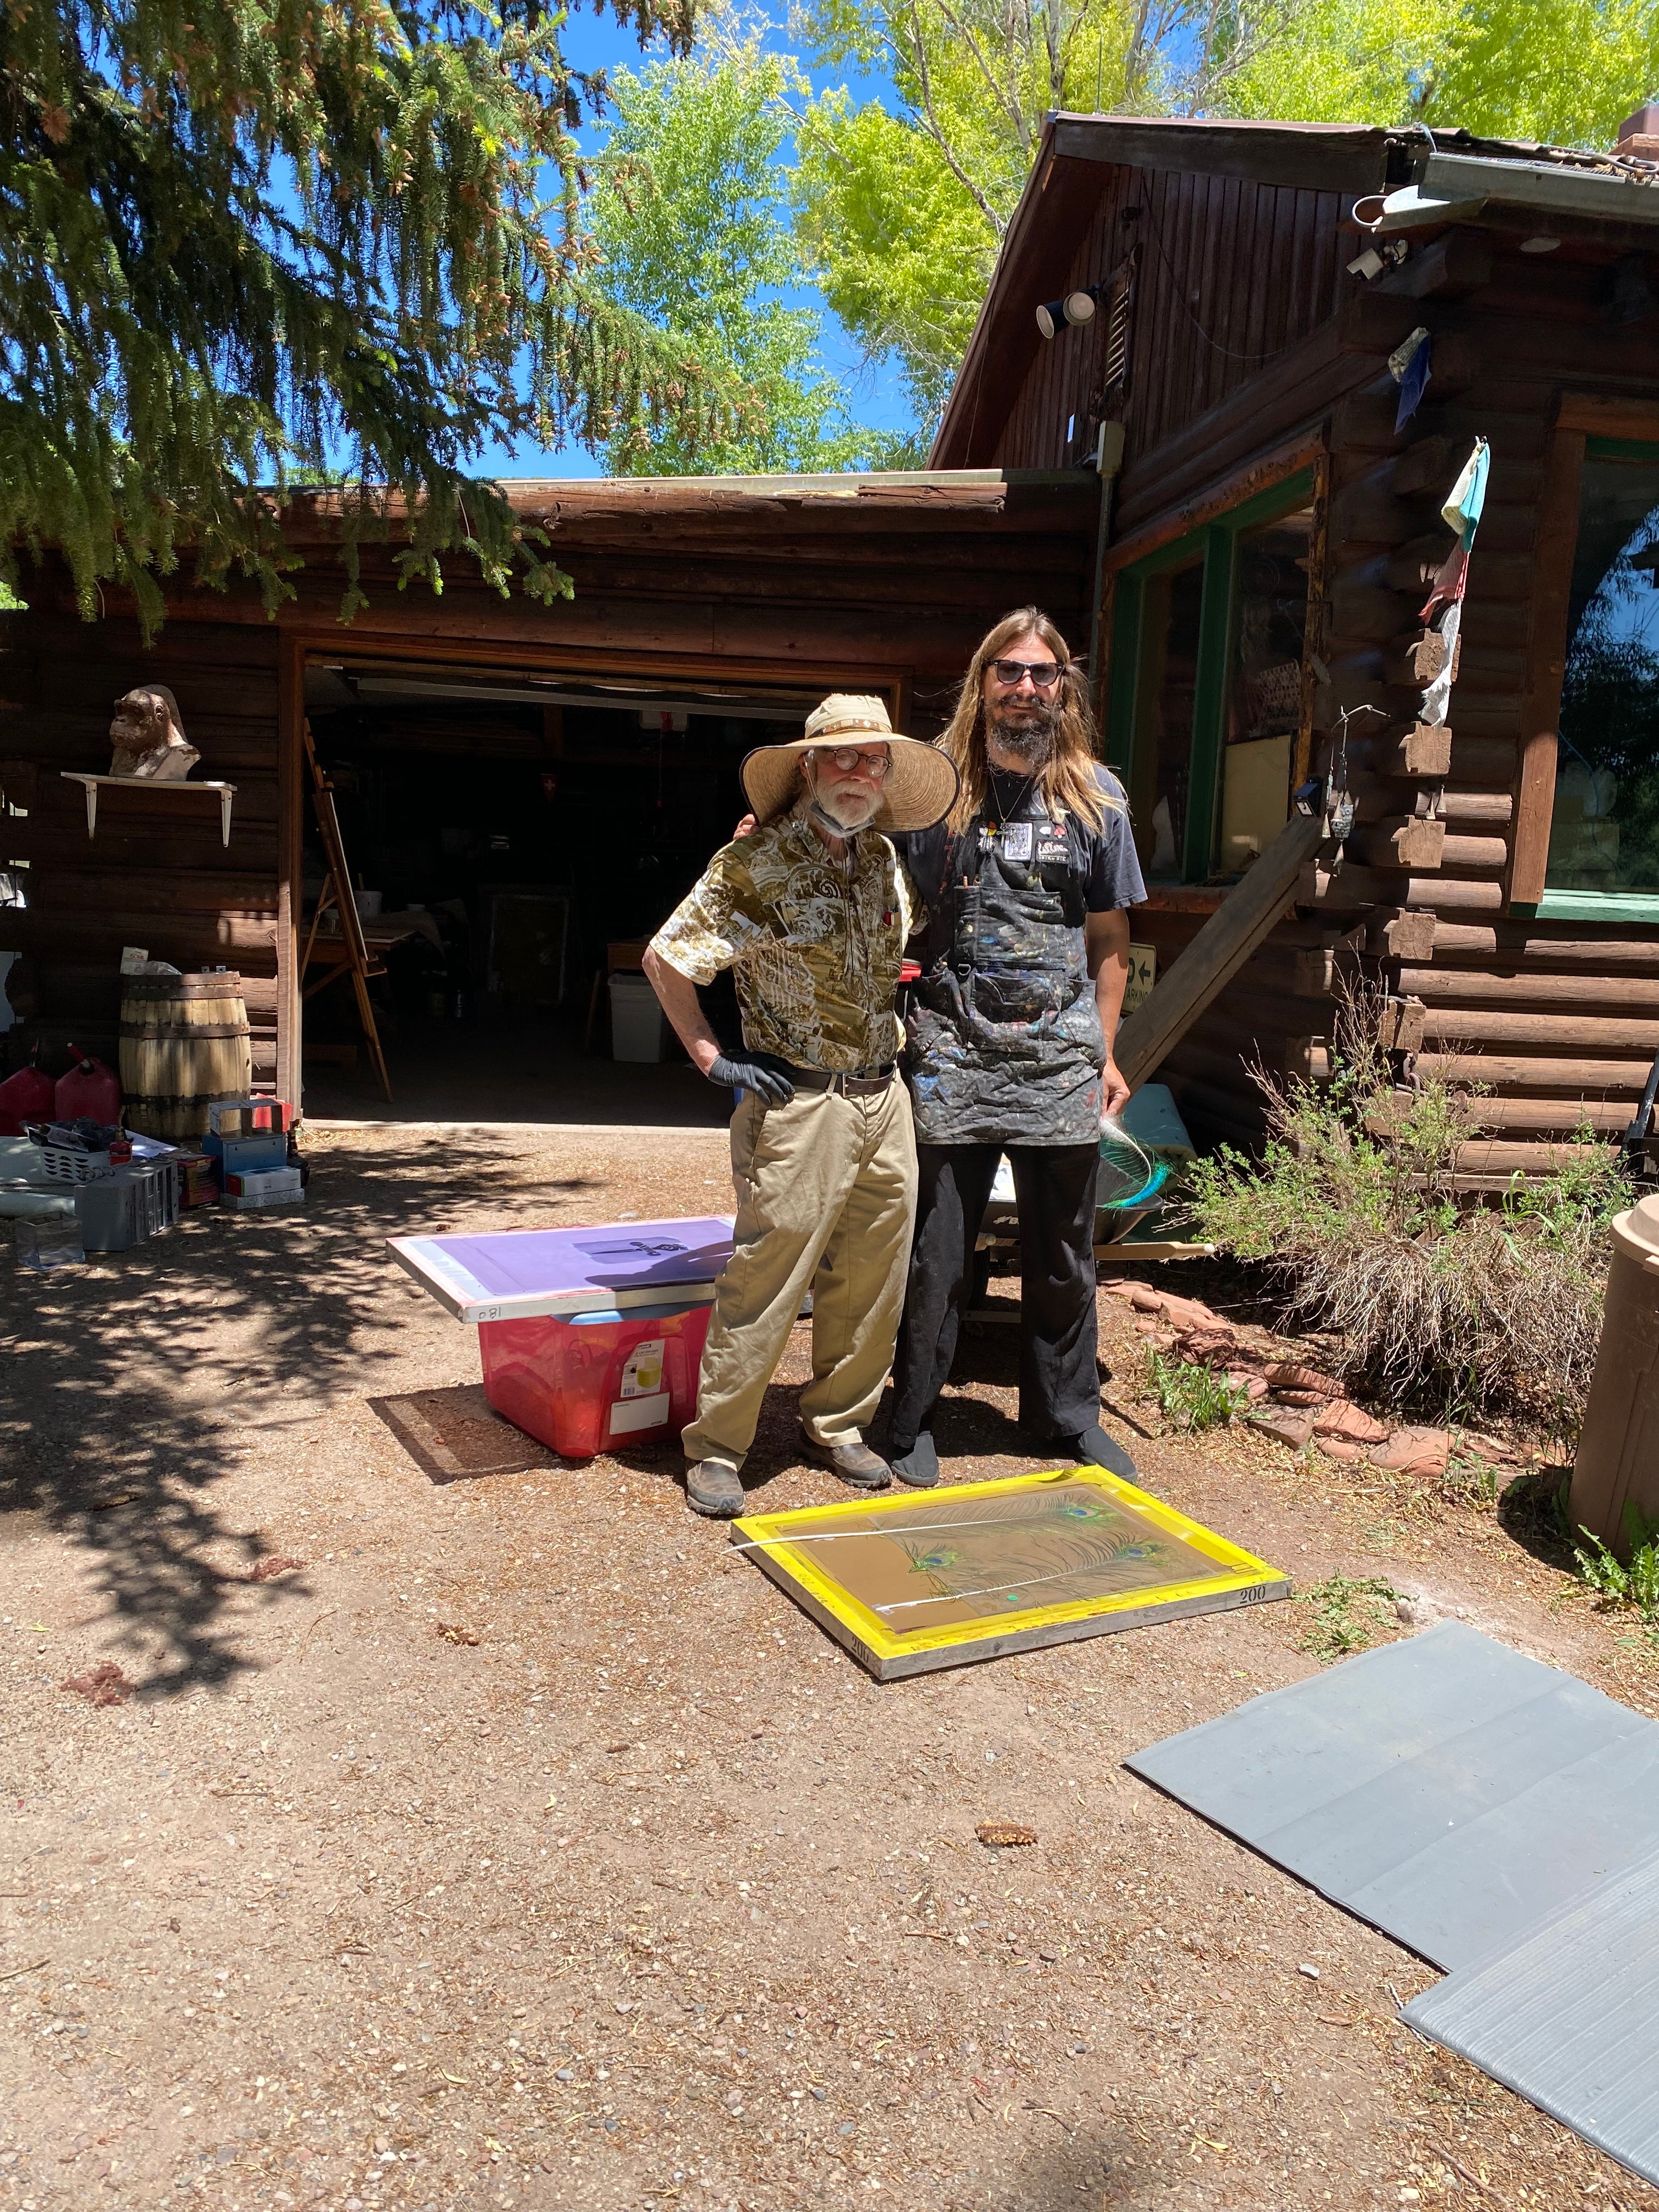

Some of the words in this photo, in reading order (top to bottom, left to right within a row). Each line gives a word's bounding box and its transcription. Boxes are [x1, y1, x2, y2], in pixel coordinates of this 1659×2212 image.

[1126, 988, 1148, 1004] ARKIN
[1239, 1585, 1266, 1604] 200
[851, 1635, 869, 1663] 200
